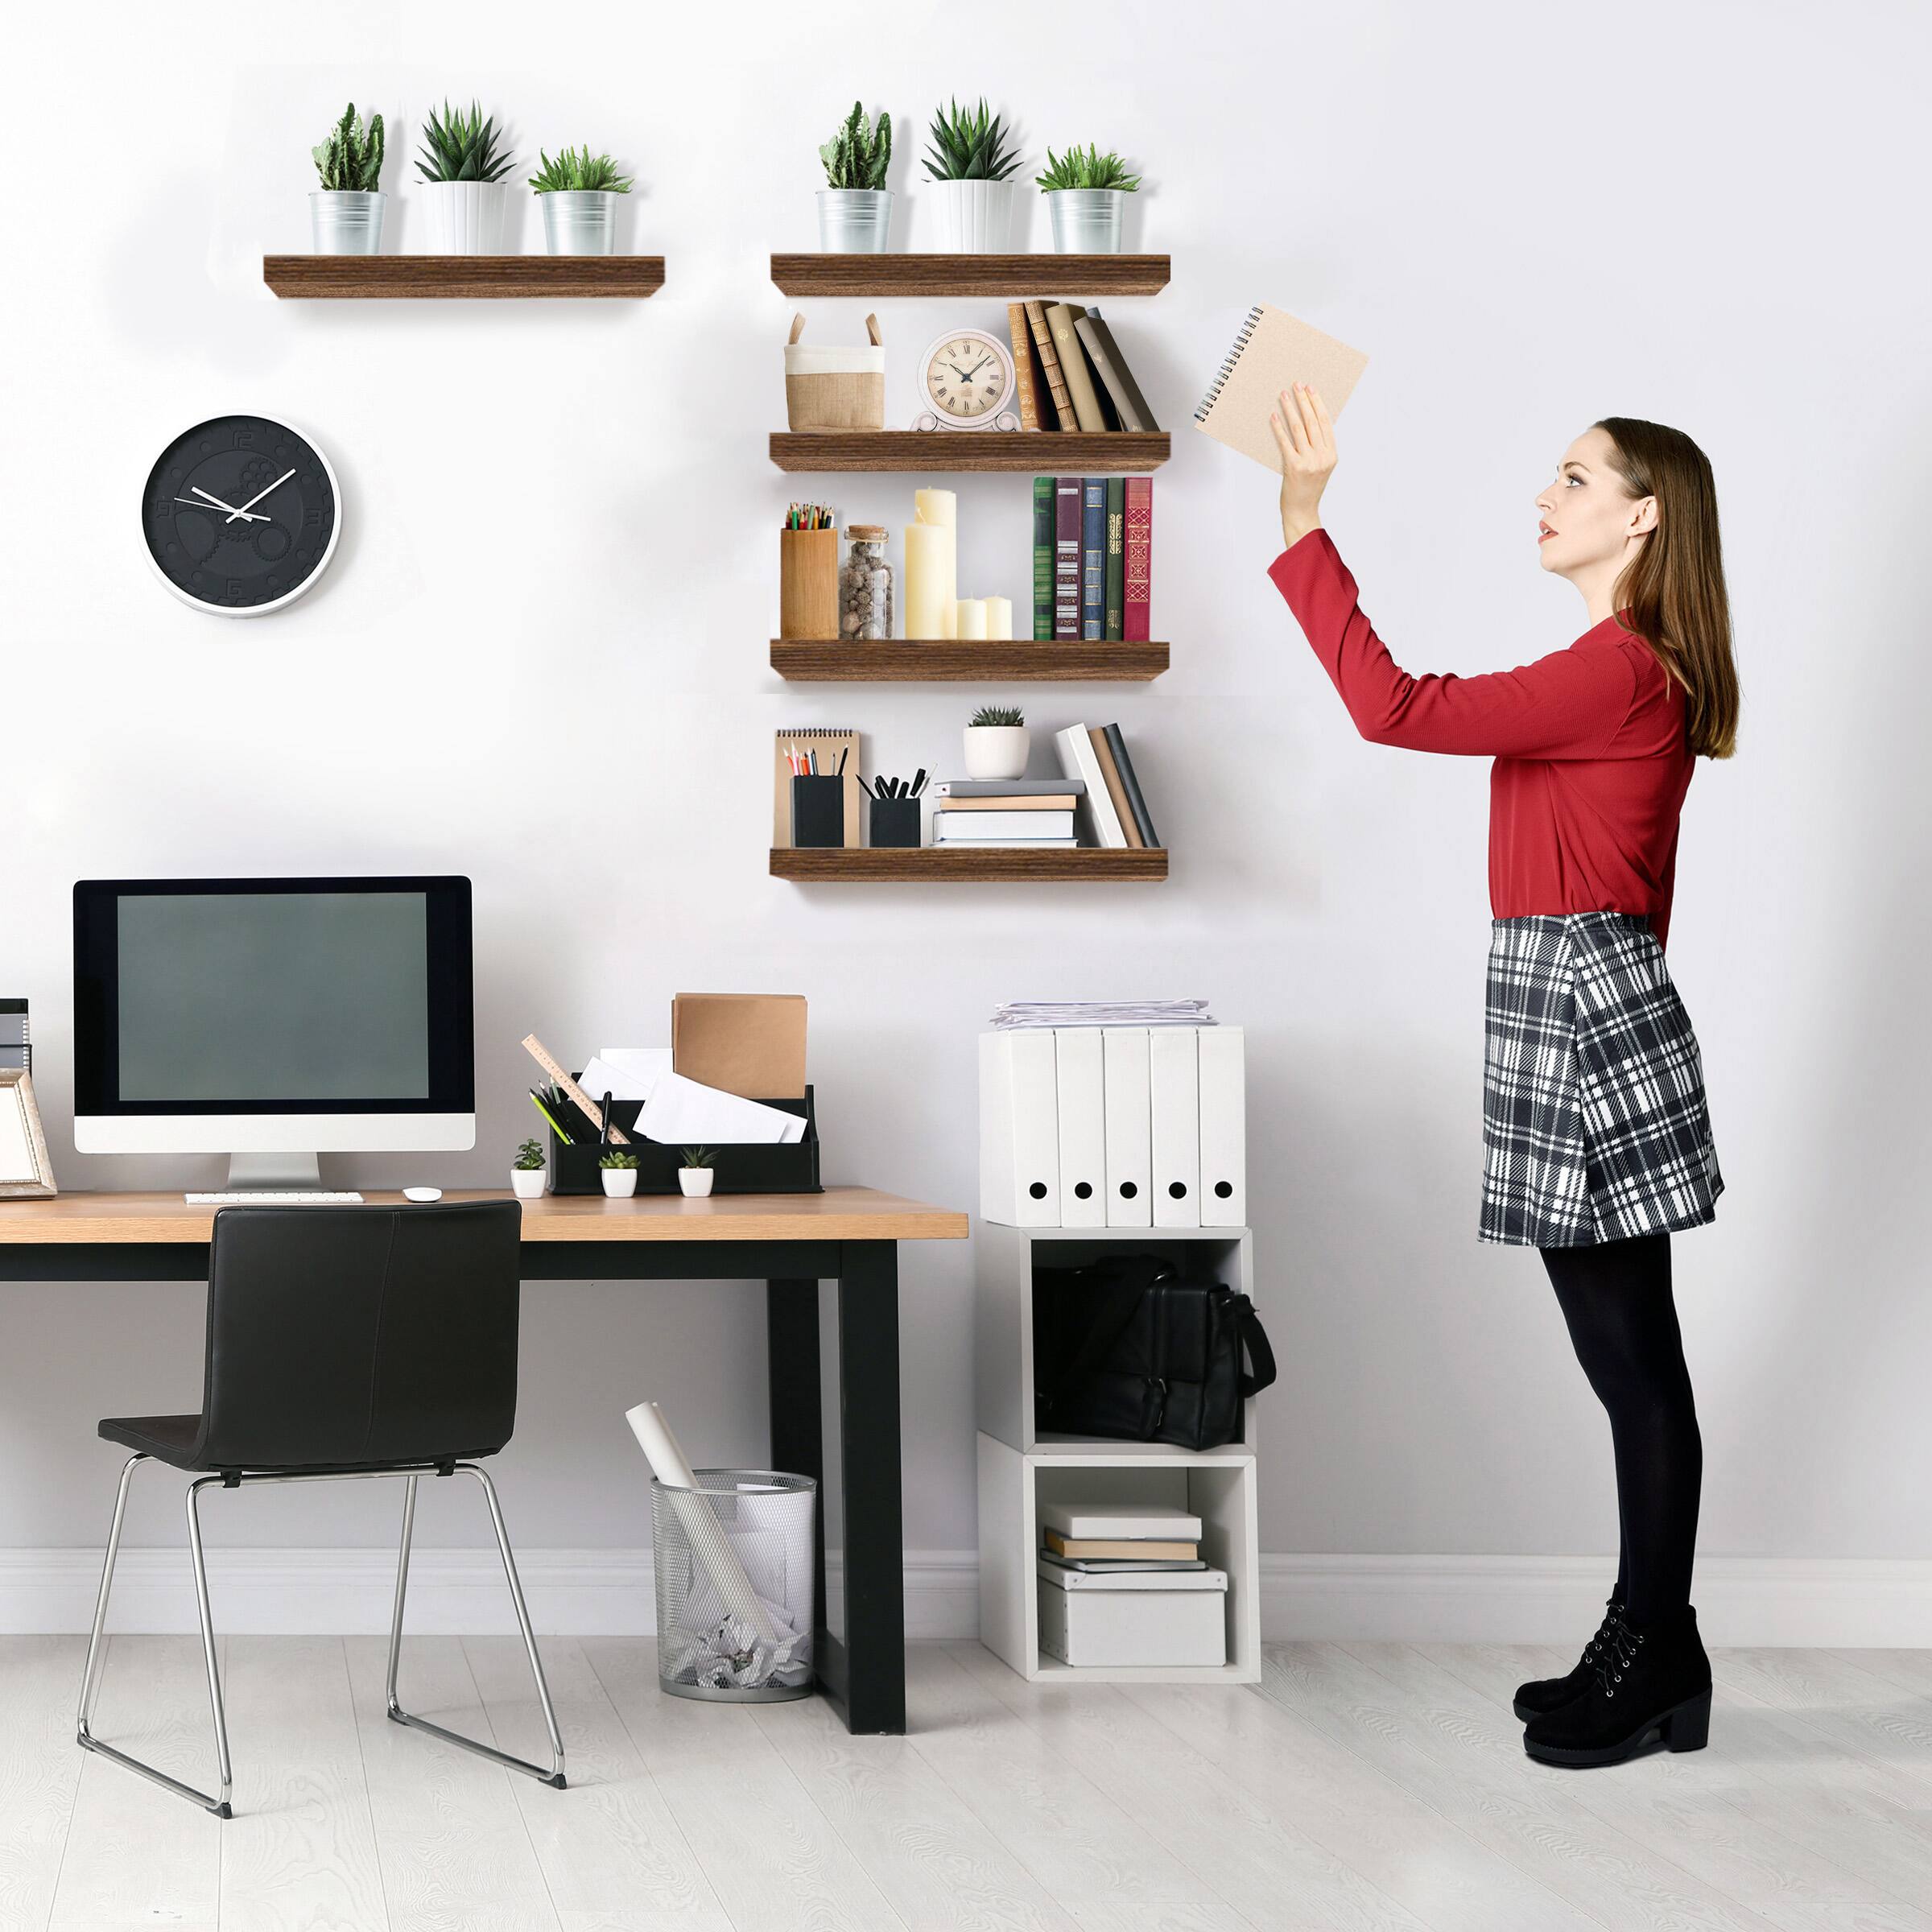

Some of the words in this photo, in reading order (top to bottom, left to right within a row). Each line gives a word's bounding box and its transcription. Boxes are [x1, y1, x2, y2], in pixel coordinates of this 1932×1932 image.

[155, 498, 173, 518] 9
[304, 508, 322, 527] 3
[225, 578, 243, 598] 6
